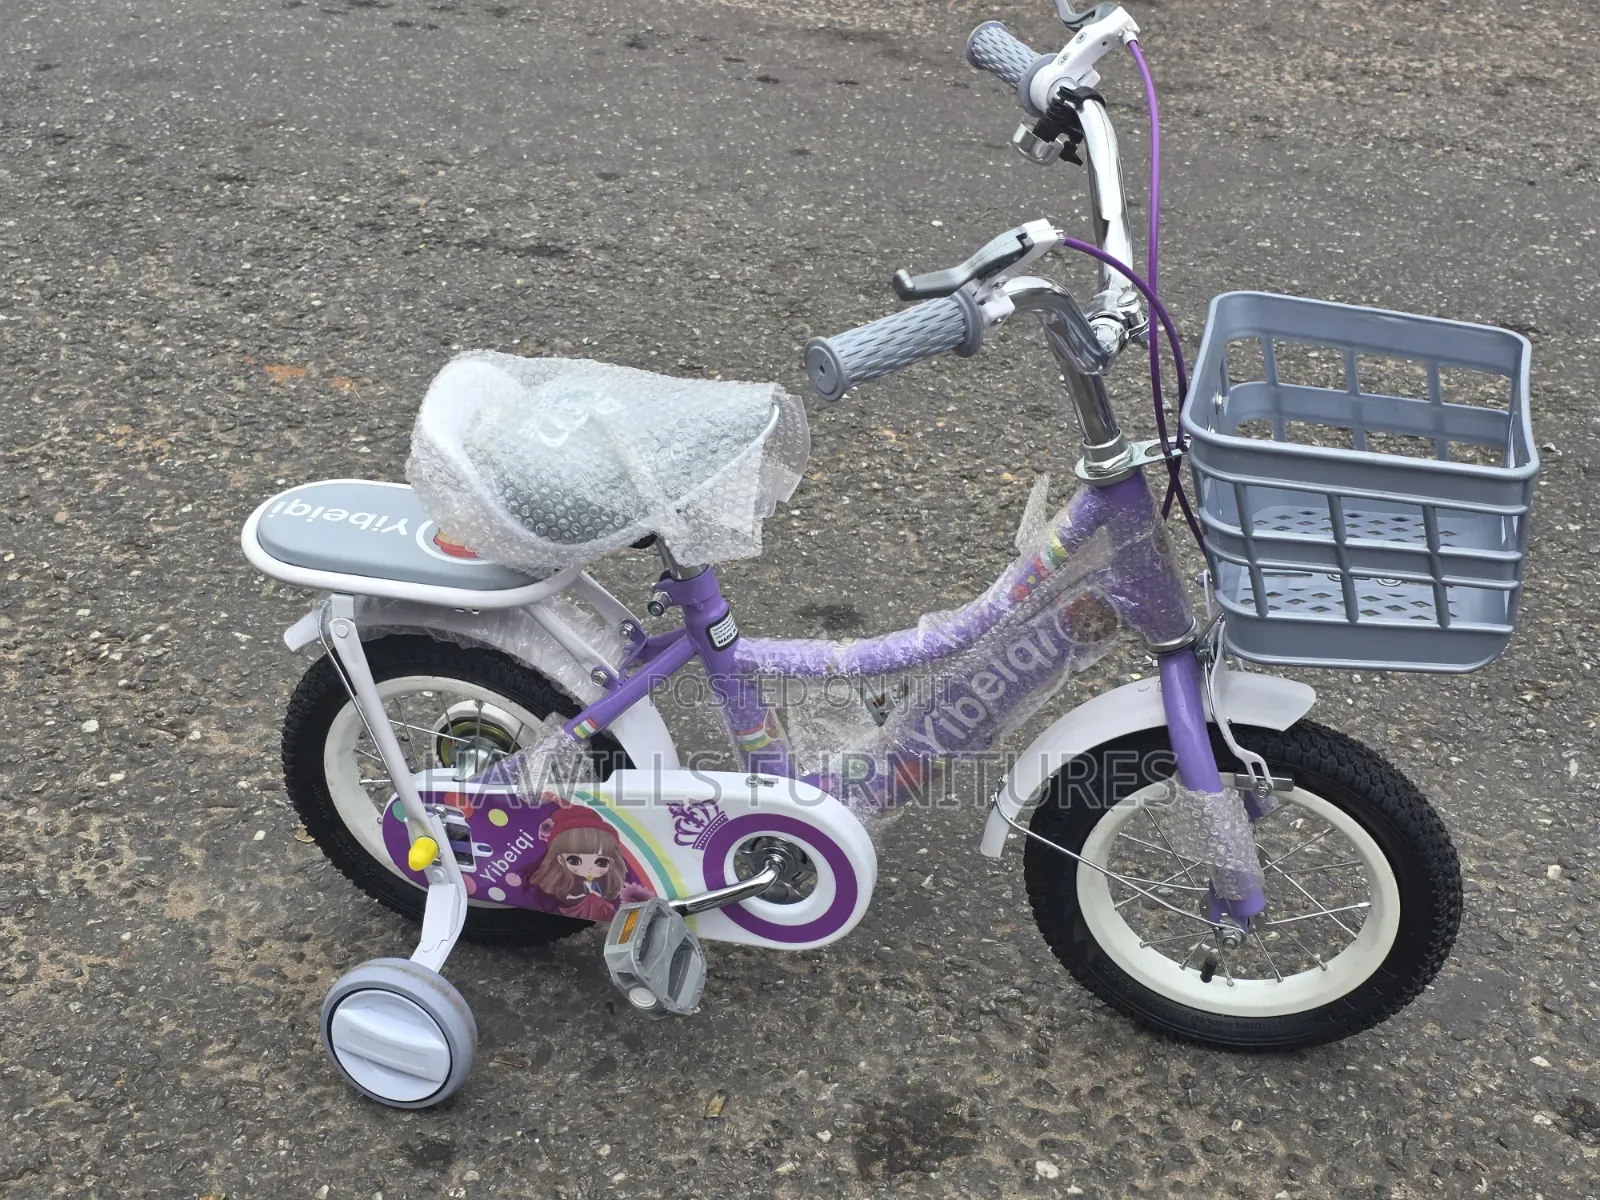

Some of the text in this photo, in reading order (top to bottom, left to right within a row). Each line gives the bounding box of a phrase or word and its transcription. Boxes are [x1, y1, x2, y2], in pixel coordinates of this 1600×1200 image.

[267, 498, 408, 536] Yibeiqi
[908, 624, 1059, 754] Yibeiqi
[479, 828, 535, 883] Yibeiqi
